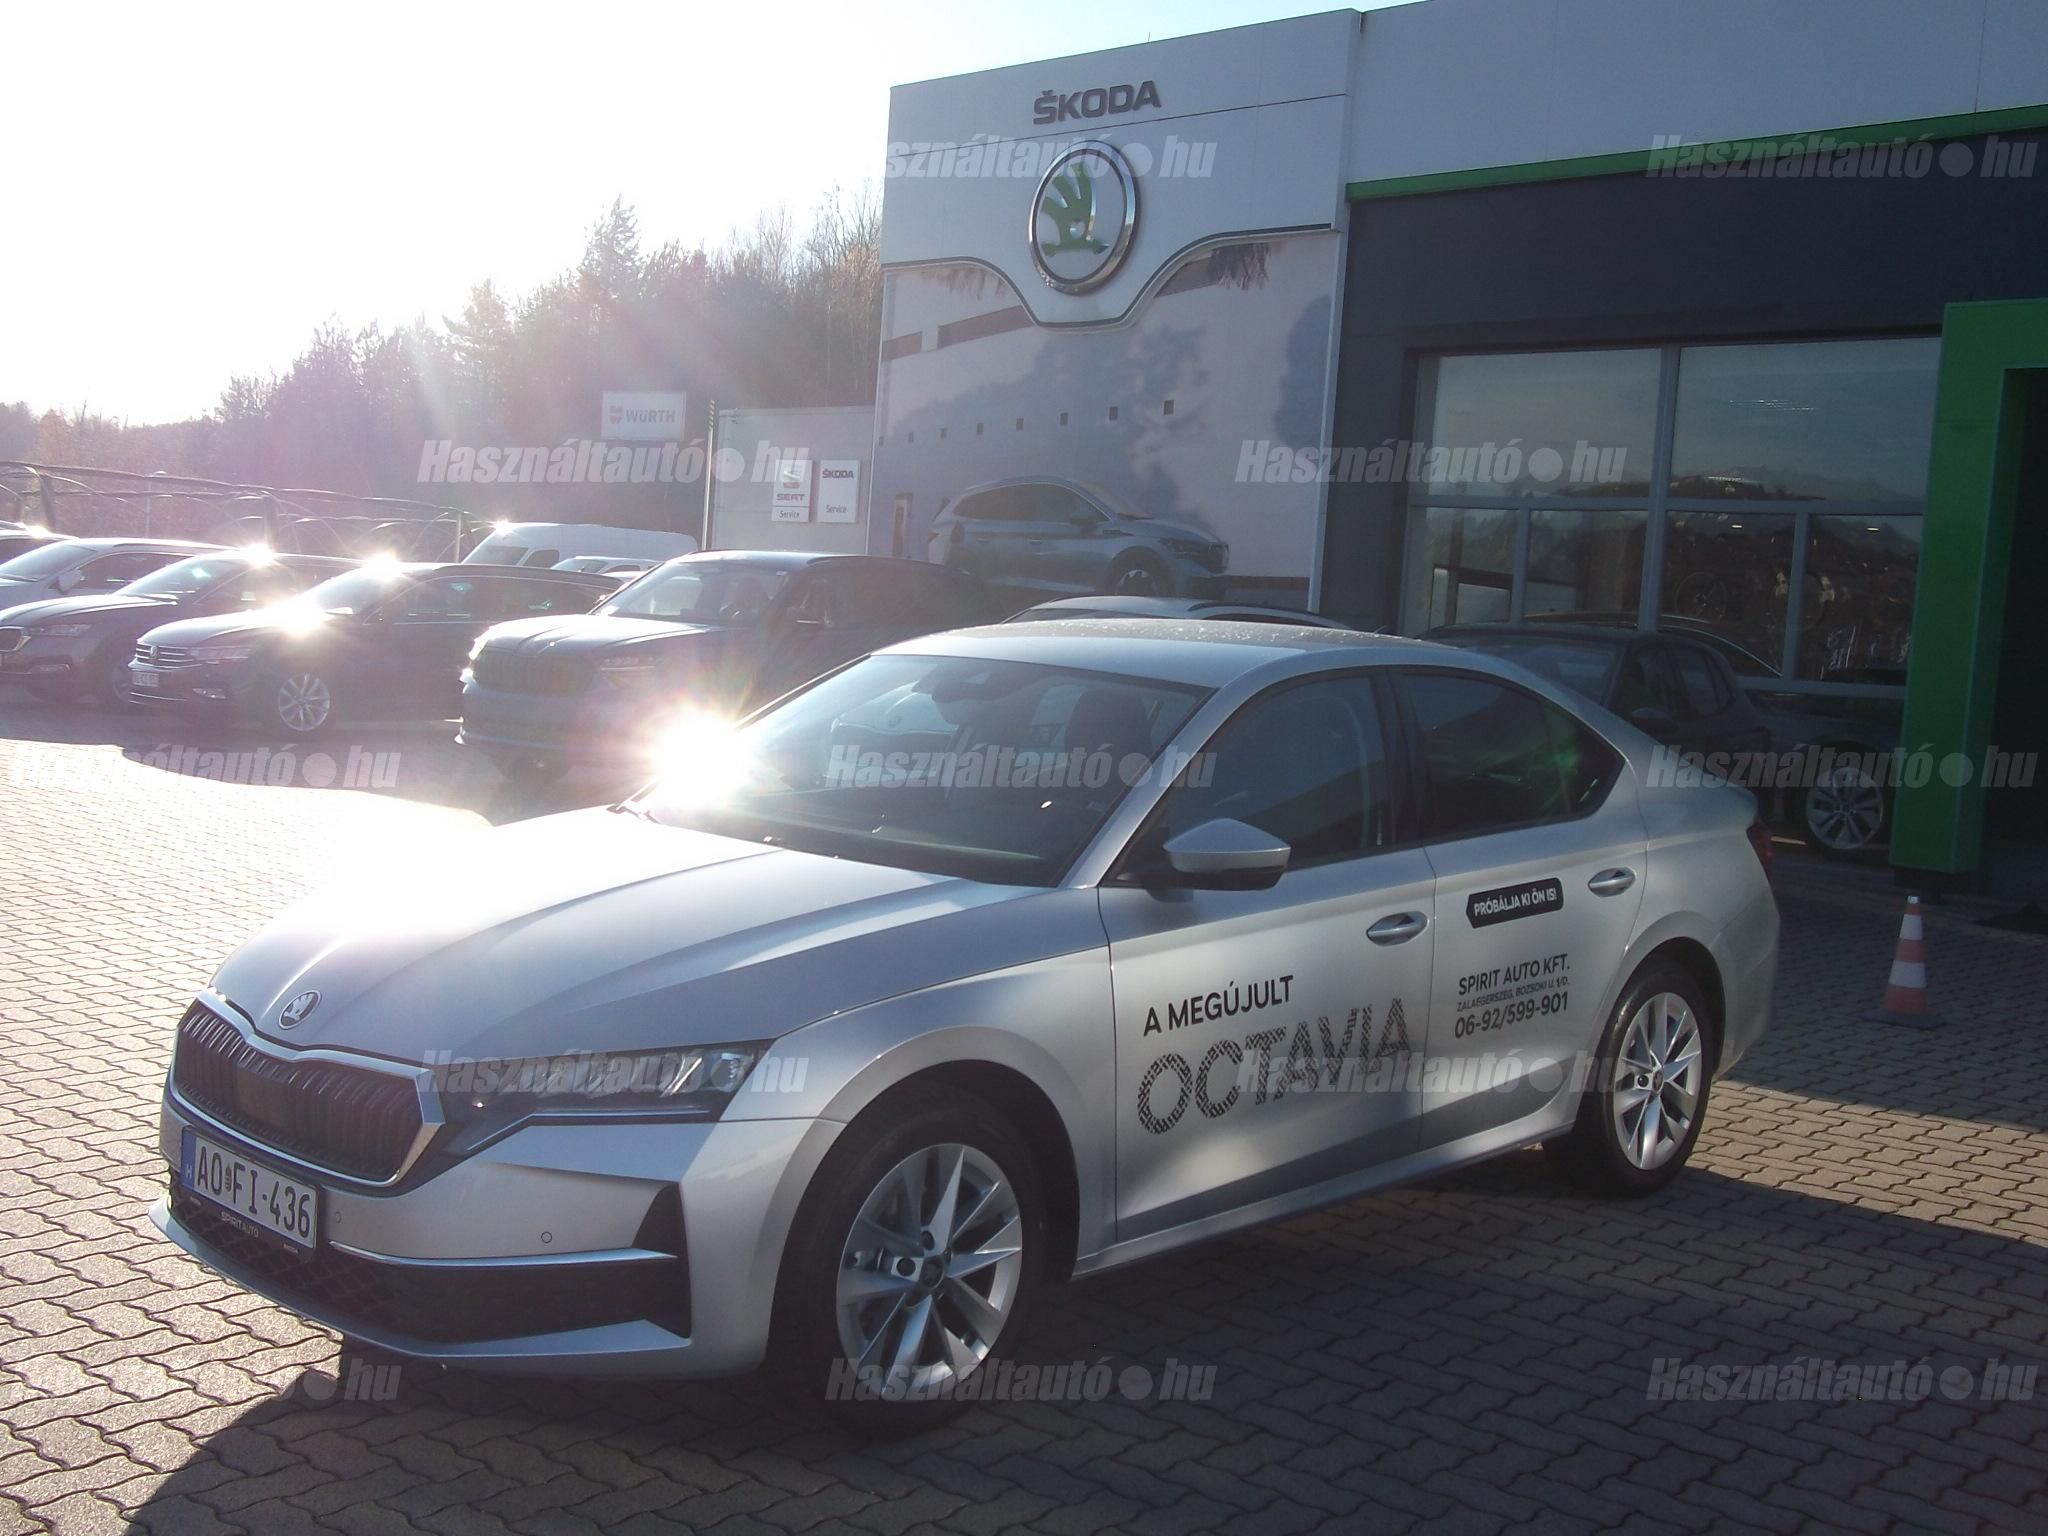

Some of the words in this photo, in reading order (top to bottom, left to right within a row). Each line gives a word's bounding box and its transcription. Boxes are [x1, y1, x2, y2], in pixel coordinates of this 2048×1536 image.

[1033, 80, 1161, 125] ŠKODA
[626, 408, 676, 423] WÜRTH
[822, 468, 854, 478] ŠKODA
[780, 510, 800, 519] Service
[826, 505, 847, 513] Service
[1474, 895, 1520, 916] PRÓBÁLJA
[1521, 893, 1531, 906] KI
[1547, 887, 1557, 902] IS!
[1458, 969, 1500, 995] SPIRIT
[1503, 960, 1540, 985] AUTO
[1543, 953, 1570, 975] KFT.
[1144, 1007, 1161, 1037] A
[1168, 975, 1293, 1030] MEGÚJULT
[1455, 991, 1568, 1038] 06-92/599-901
[1138, 998, 1410, 1135] OCTAVIA
